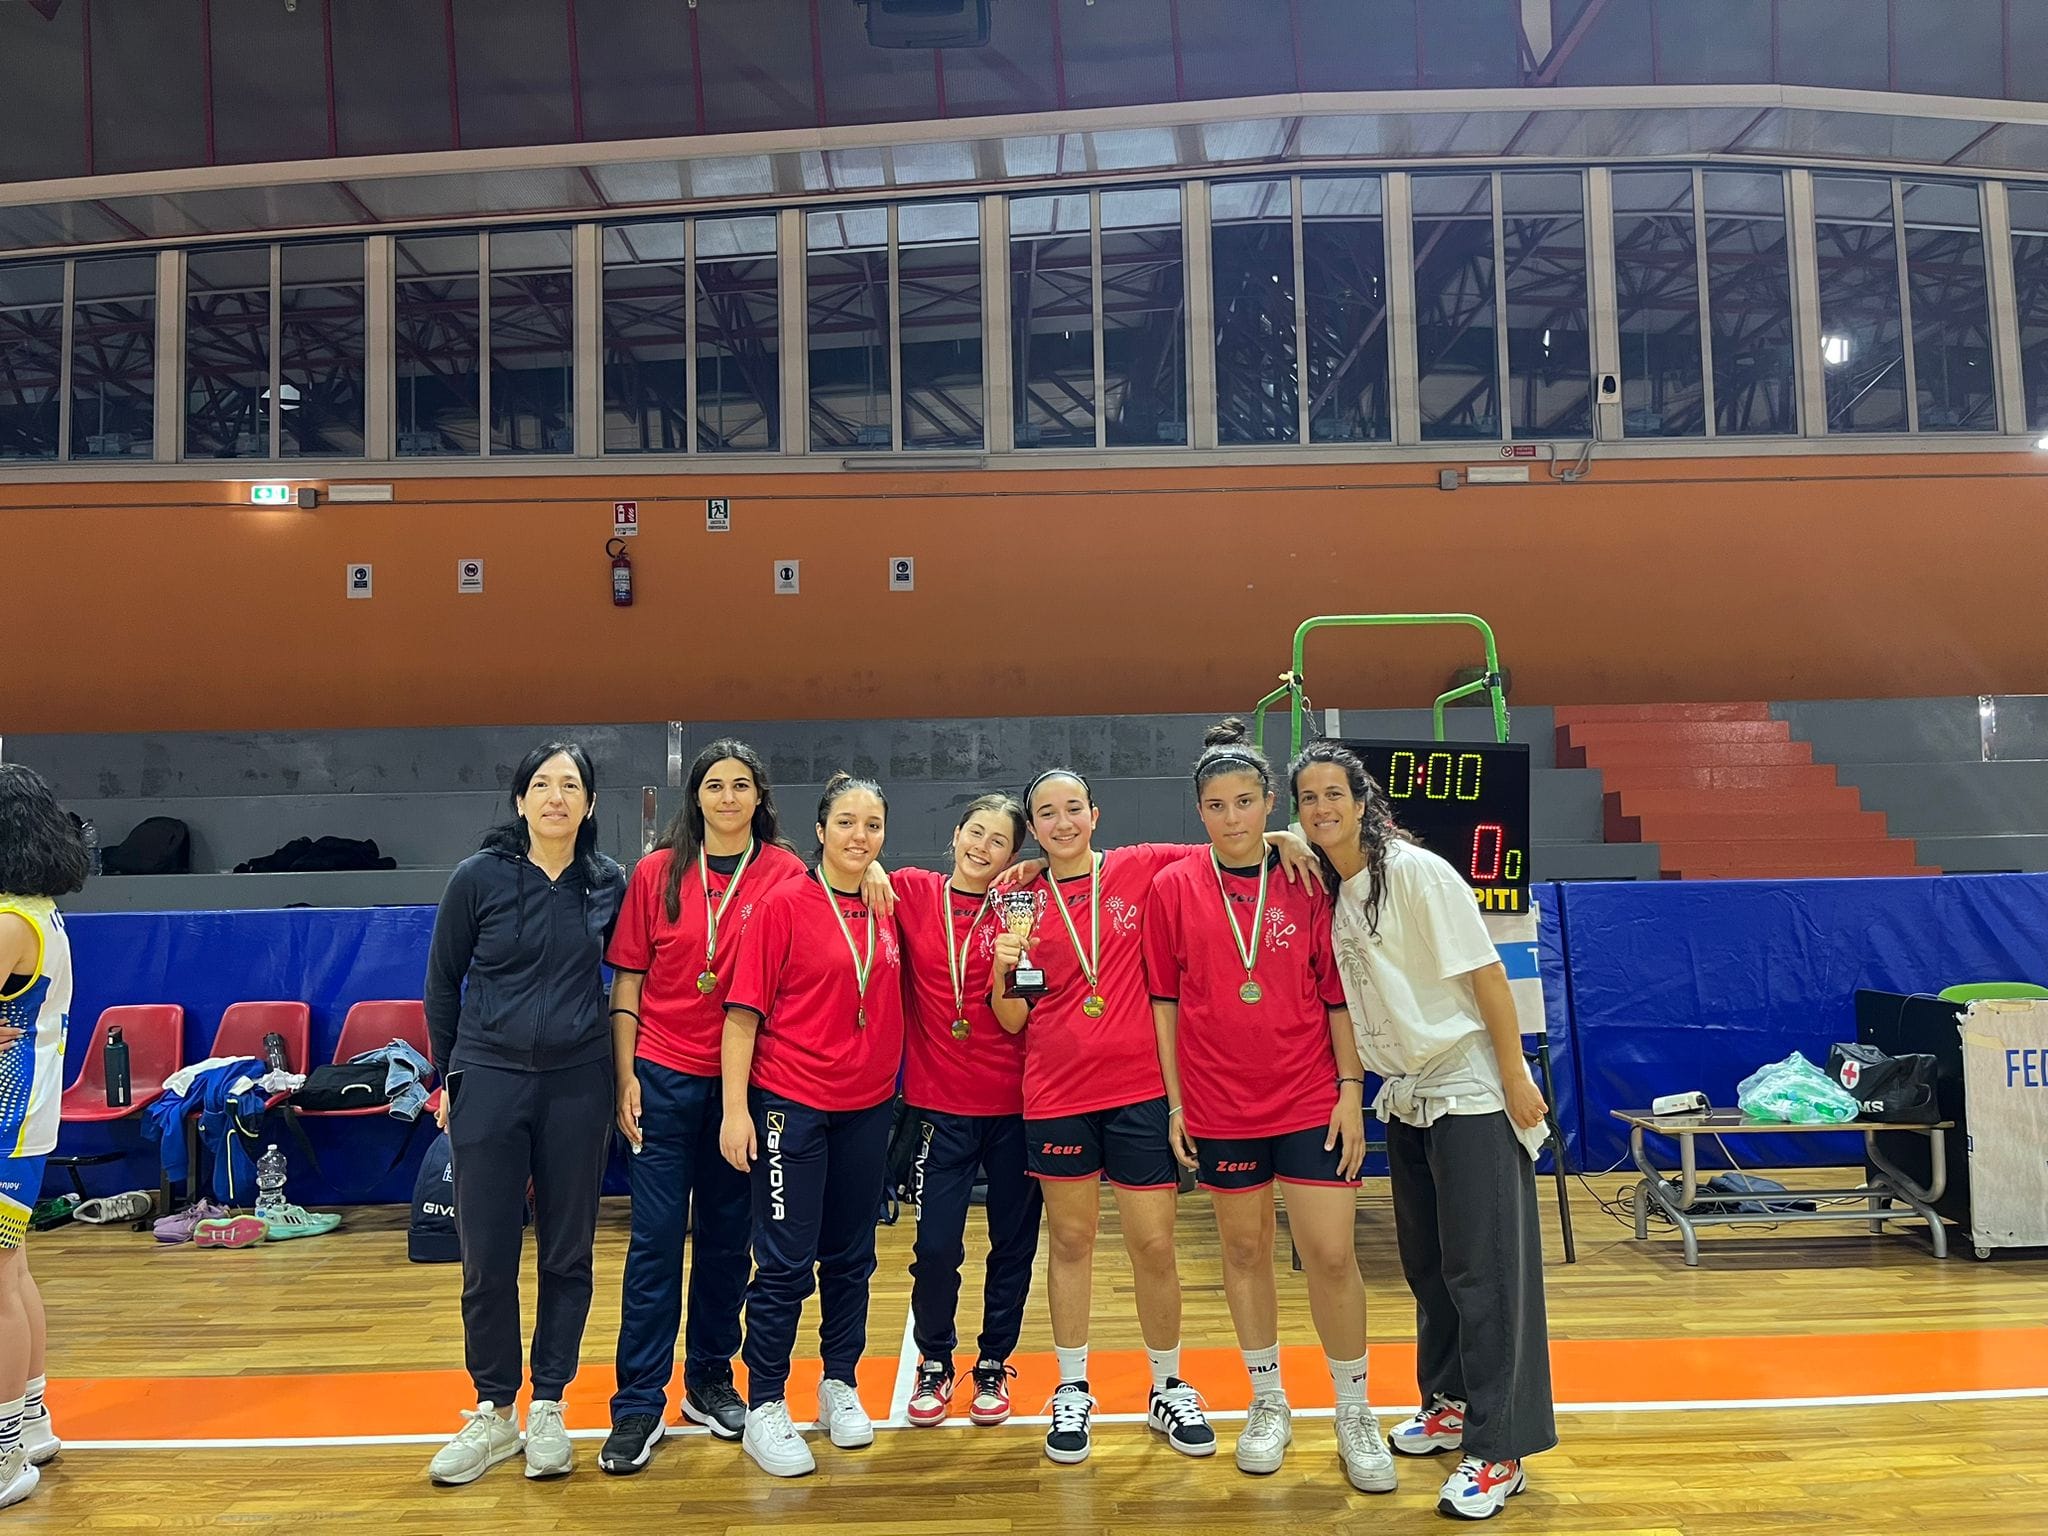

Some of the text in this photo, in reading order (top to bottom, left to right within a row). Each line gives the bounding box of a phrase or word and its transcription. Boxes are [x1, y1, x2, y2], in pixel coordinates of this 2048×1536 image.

[1389, 752, 1482, 800] 0:00
[1471, 824, 1502, 879] 0
[1504, 849, 1521, 879] 0
[843, 910, 866, 918] Zeu
[1041, 1142, 1082, 1154] Zeus
[1215, 1160, 1257, 1172] Zeus
[767, 1131, 785, 1220] GIVOVA
[0, 1181, 20, 1191] njoy
[1248, 1362, 1277, 1374] FILA
